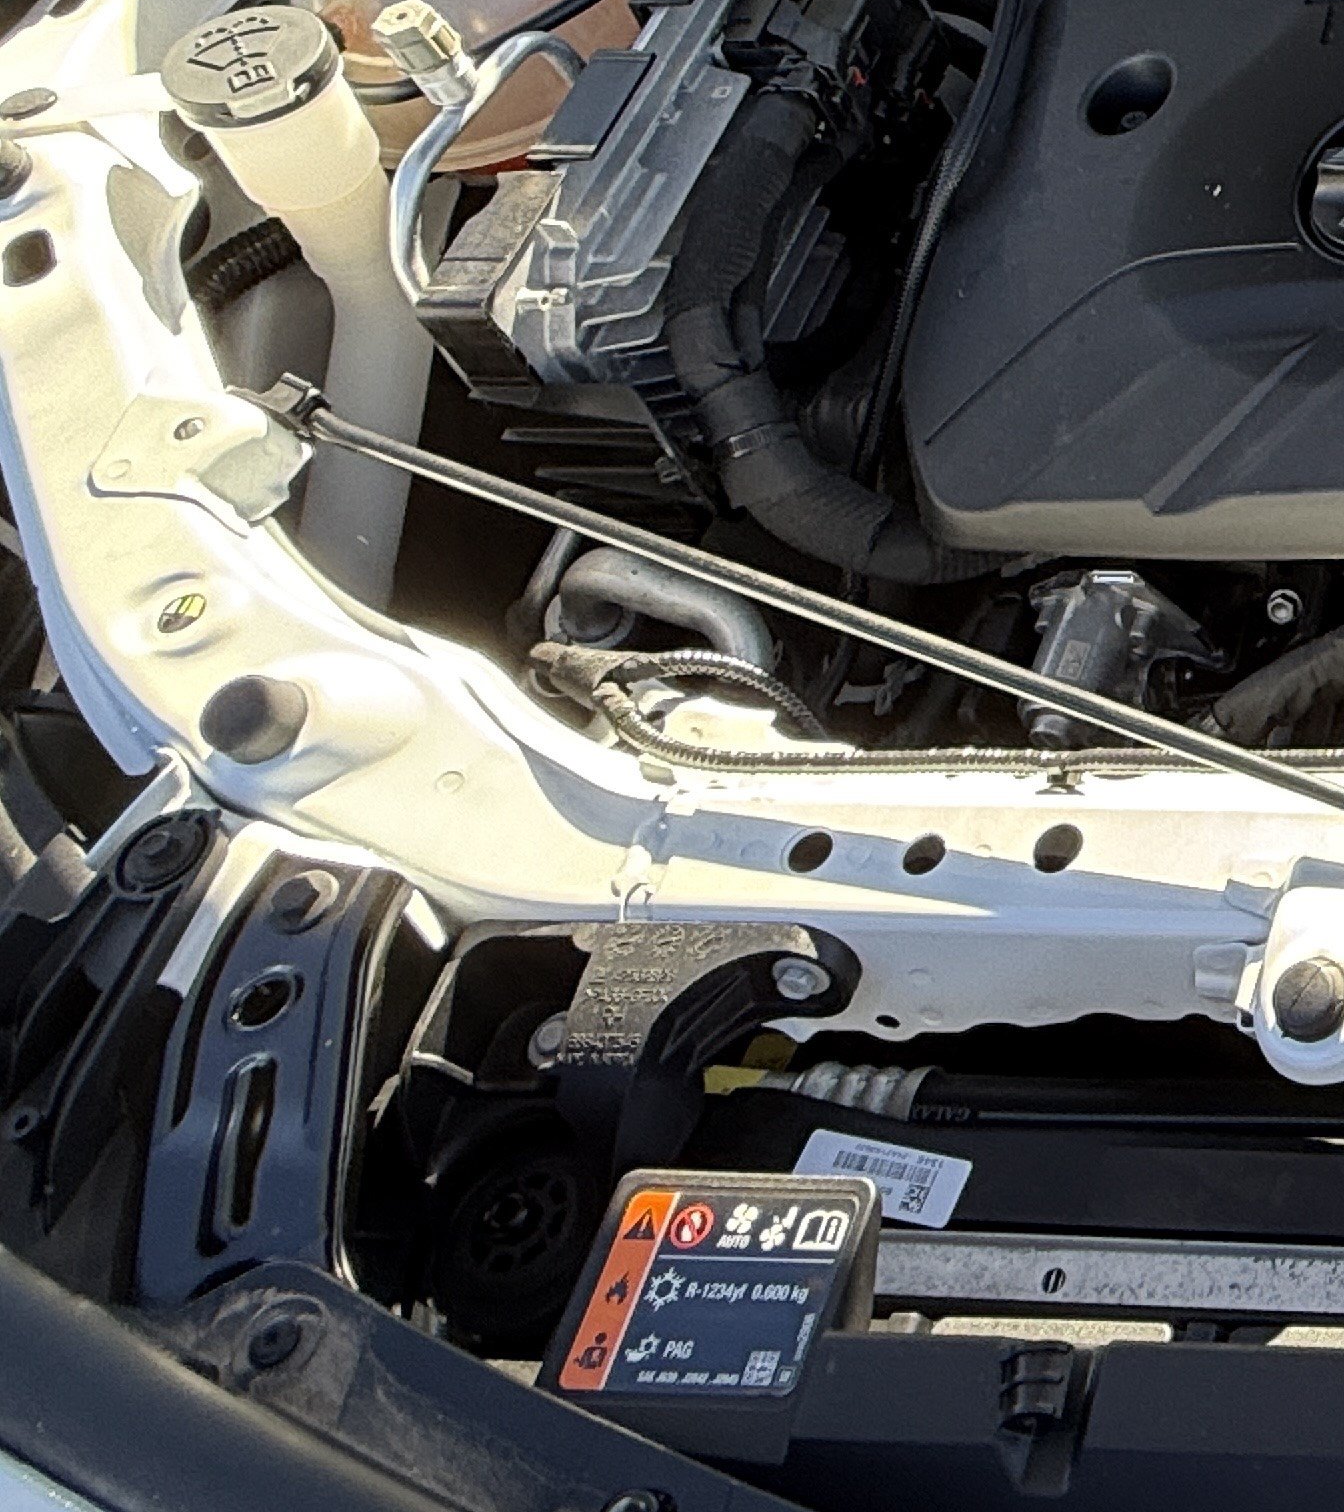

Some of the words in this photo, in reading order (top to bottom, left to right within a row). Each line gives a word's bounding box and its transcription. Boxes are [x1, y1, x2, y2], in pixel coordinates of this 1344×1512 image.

[716, 1234, 751, 1250] AUTO
[684, 1281, 750, 1304] R-1234yf
[790, 1284, 810, 1306] kg
[662, 1340, 695, 1360] PAG
